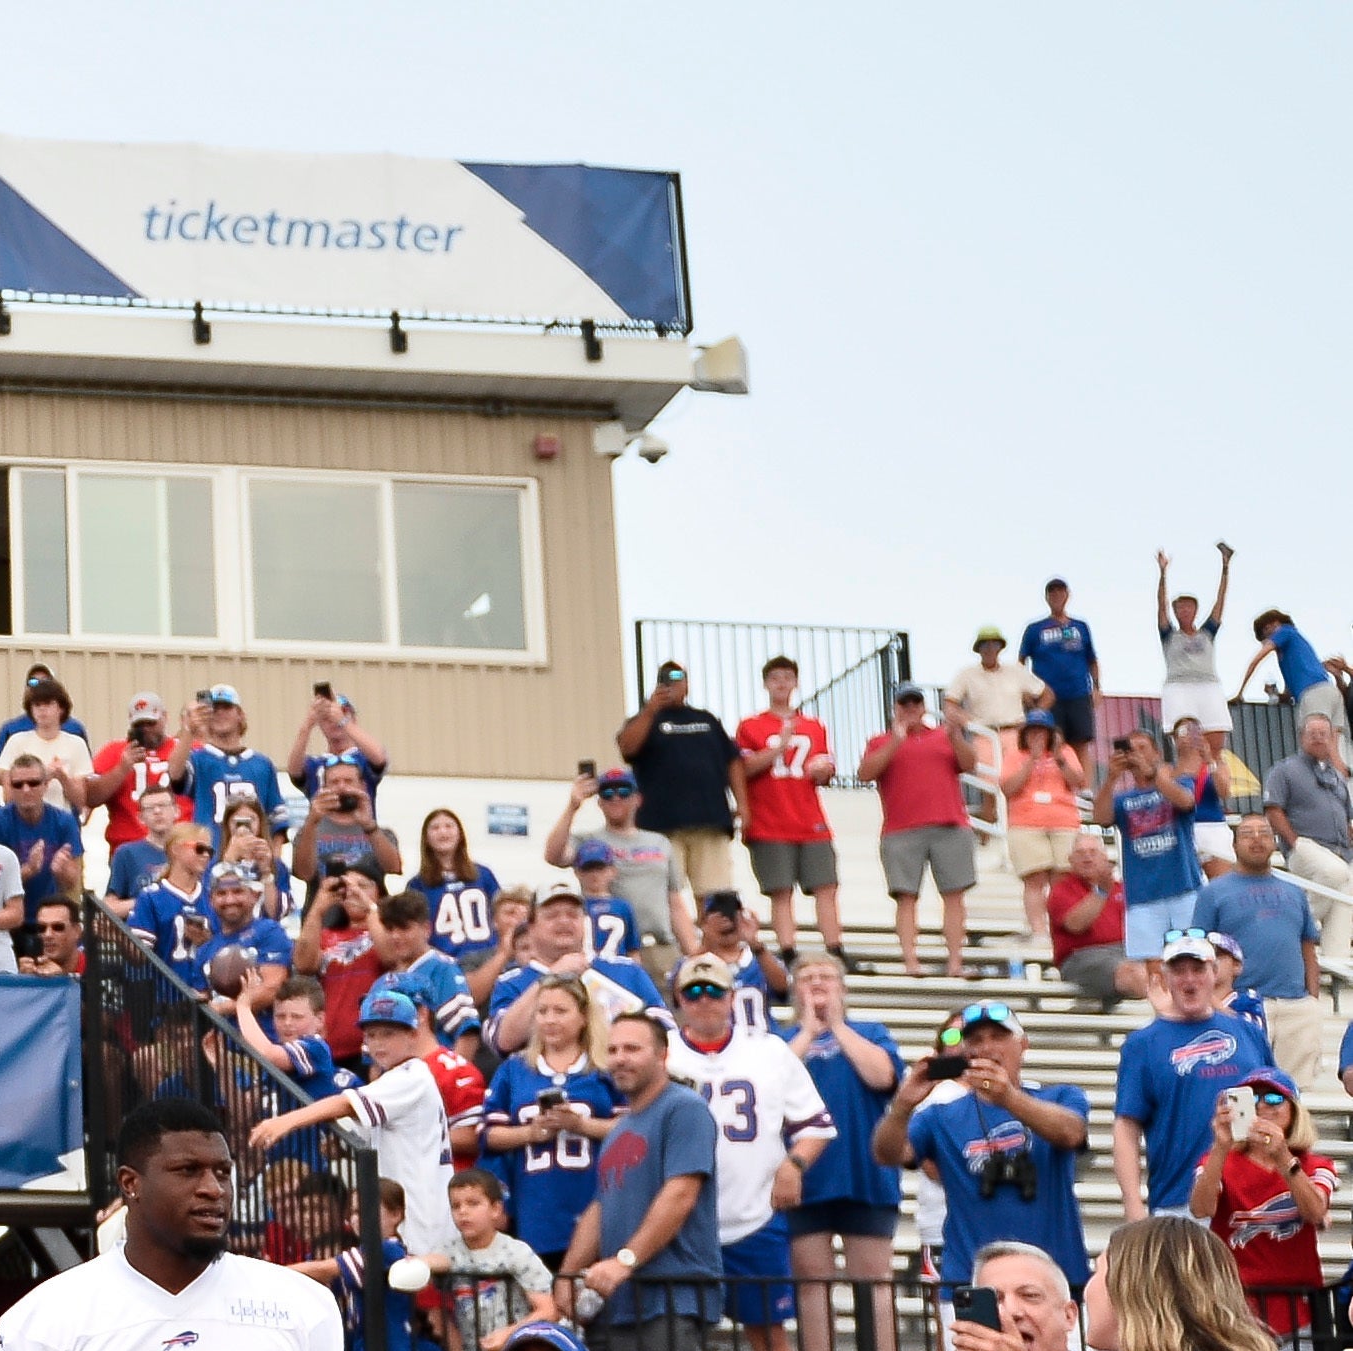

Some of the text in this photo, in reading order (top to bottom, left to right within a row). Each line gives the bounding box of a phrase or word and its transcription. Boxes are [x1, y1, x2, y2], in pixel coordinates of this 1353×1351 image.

[143, 199, 464, 252] ticketmaster
[174, 914, 209, 960] 1
[435, 887, 491, 945] 40
[705, 1080, 759, 1142] 3
